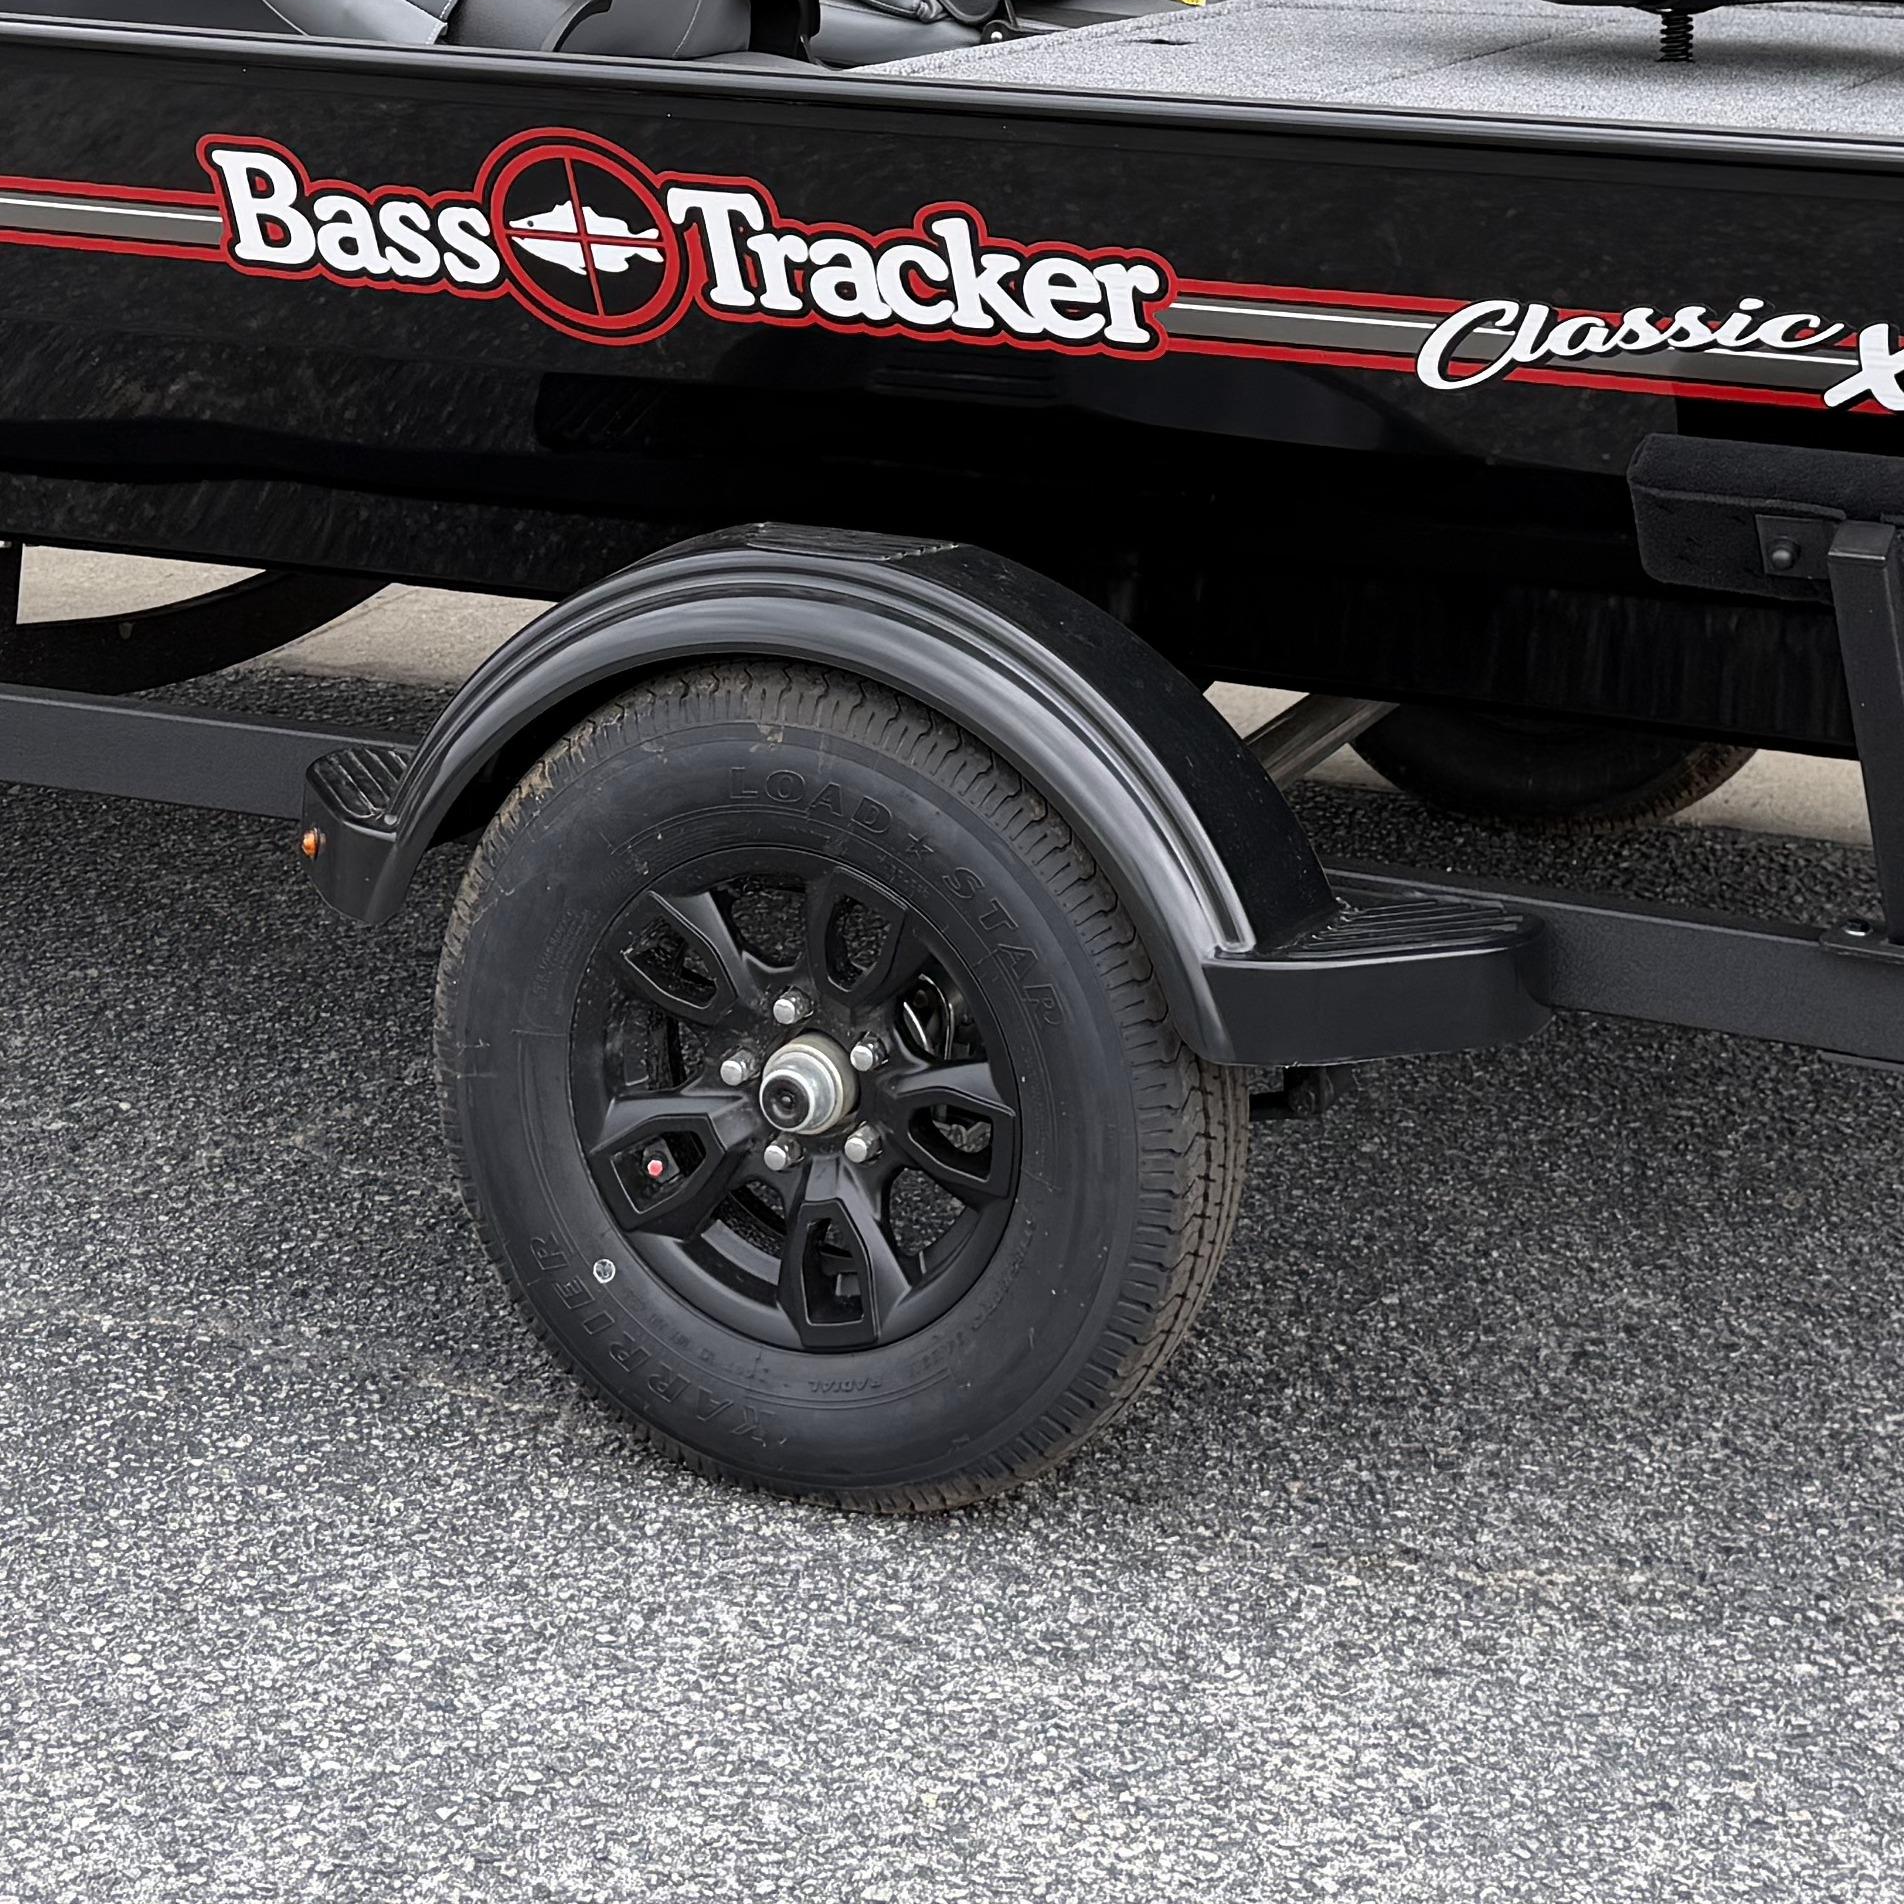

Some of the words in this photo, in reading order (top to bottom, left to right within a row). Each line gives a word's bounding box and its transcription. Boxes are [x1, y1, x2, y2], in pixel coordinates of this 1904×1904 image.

[210, 148, 500, 286] Bass
[667, 187, 1163, 345] Tracker
[1416, 298, 1844, 390] Classic
[728, 766, 894, 834] LOAD
[942, 866, 1069, 1026] STAR
